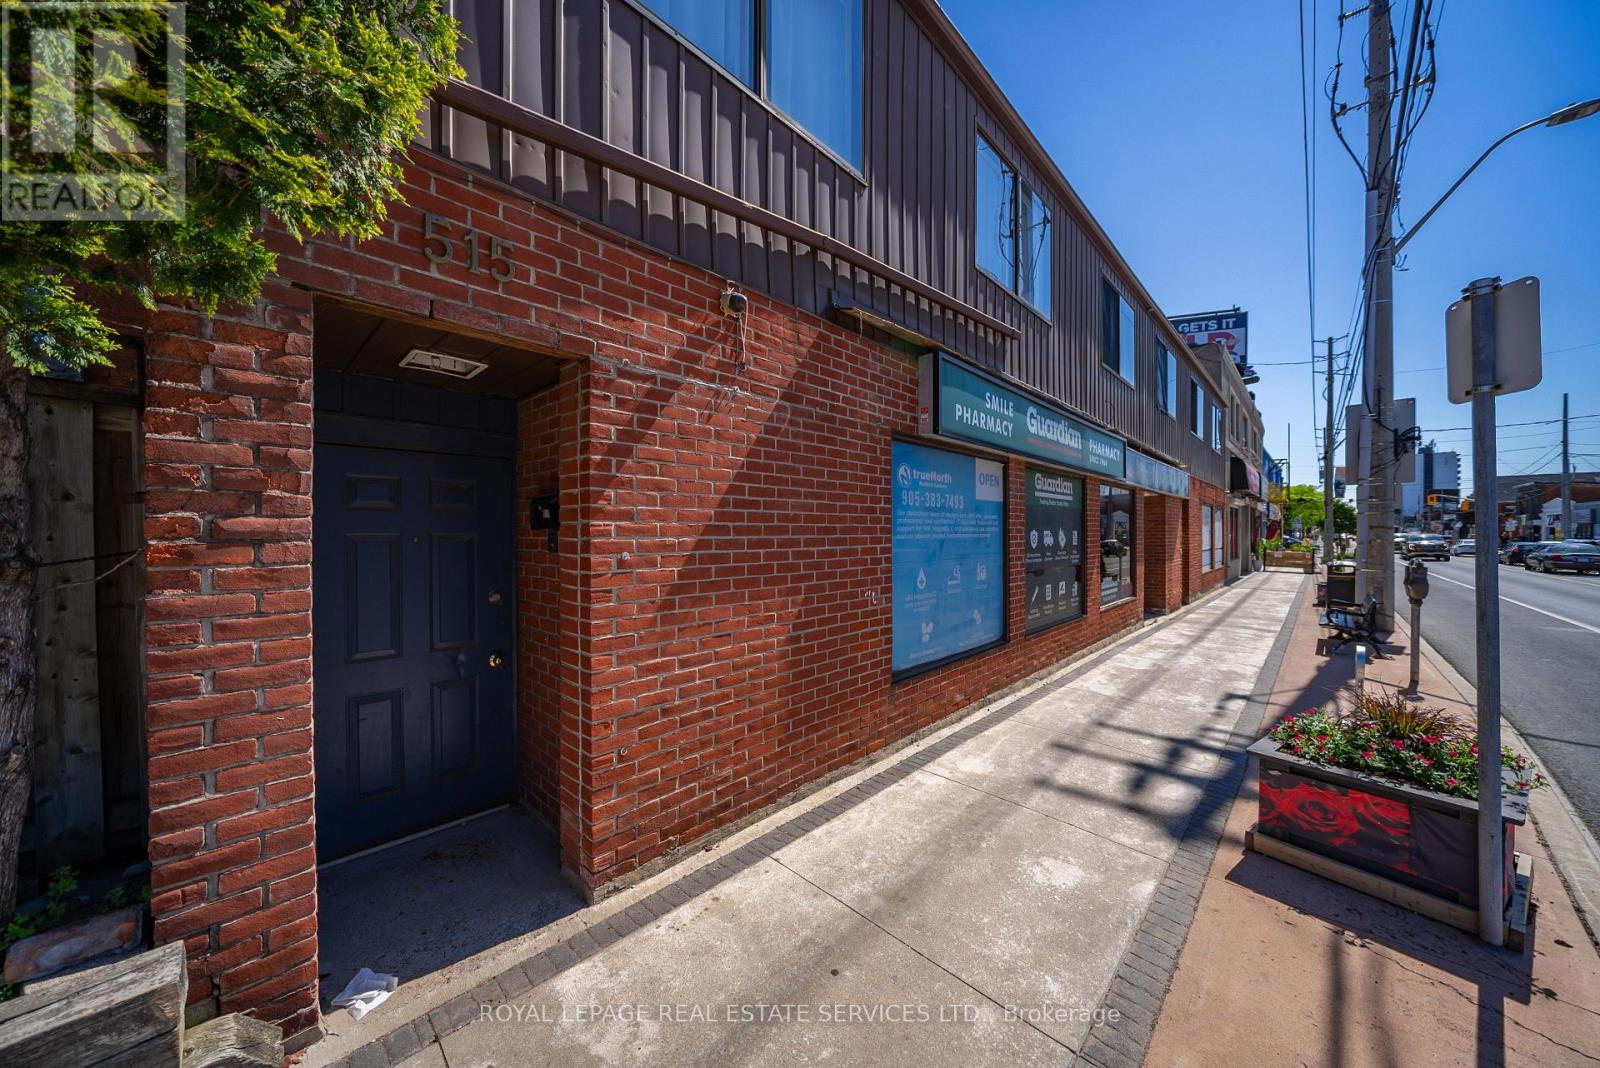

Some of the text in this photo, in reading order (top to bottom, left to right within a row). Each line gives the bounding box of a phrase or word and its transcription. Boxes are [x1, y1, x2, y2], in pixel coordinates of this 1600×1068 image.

[424, 212, 515, 281] 515
[1178, 318, 1236, 332] GETS IT
[985, 391, 1014, 417] SMILE
[955, 403, 1014, 438] PHARMACY
[1026, 406, 1082, 450] Guardian
[1089, 438, 1121, 463] PHARMACY
[912, 468, 952, 485] trueNorth
[979, 472, 1001, 488] OPEN
[1034, 472, 1074, 494] Guardian
[902, 489, 965, 509] 905-383-7493
